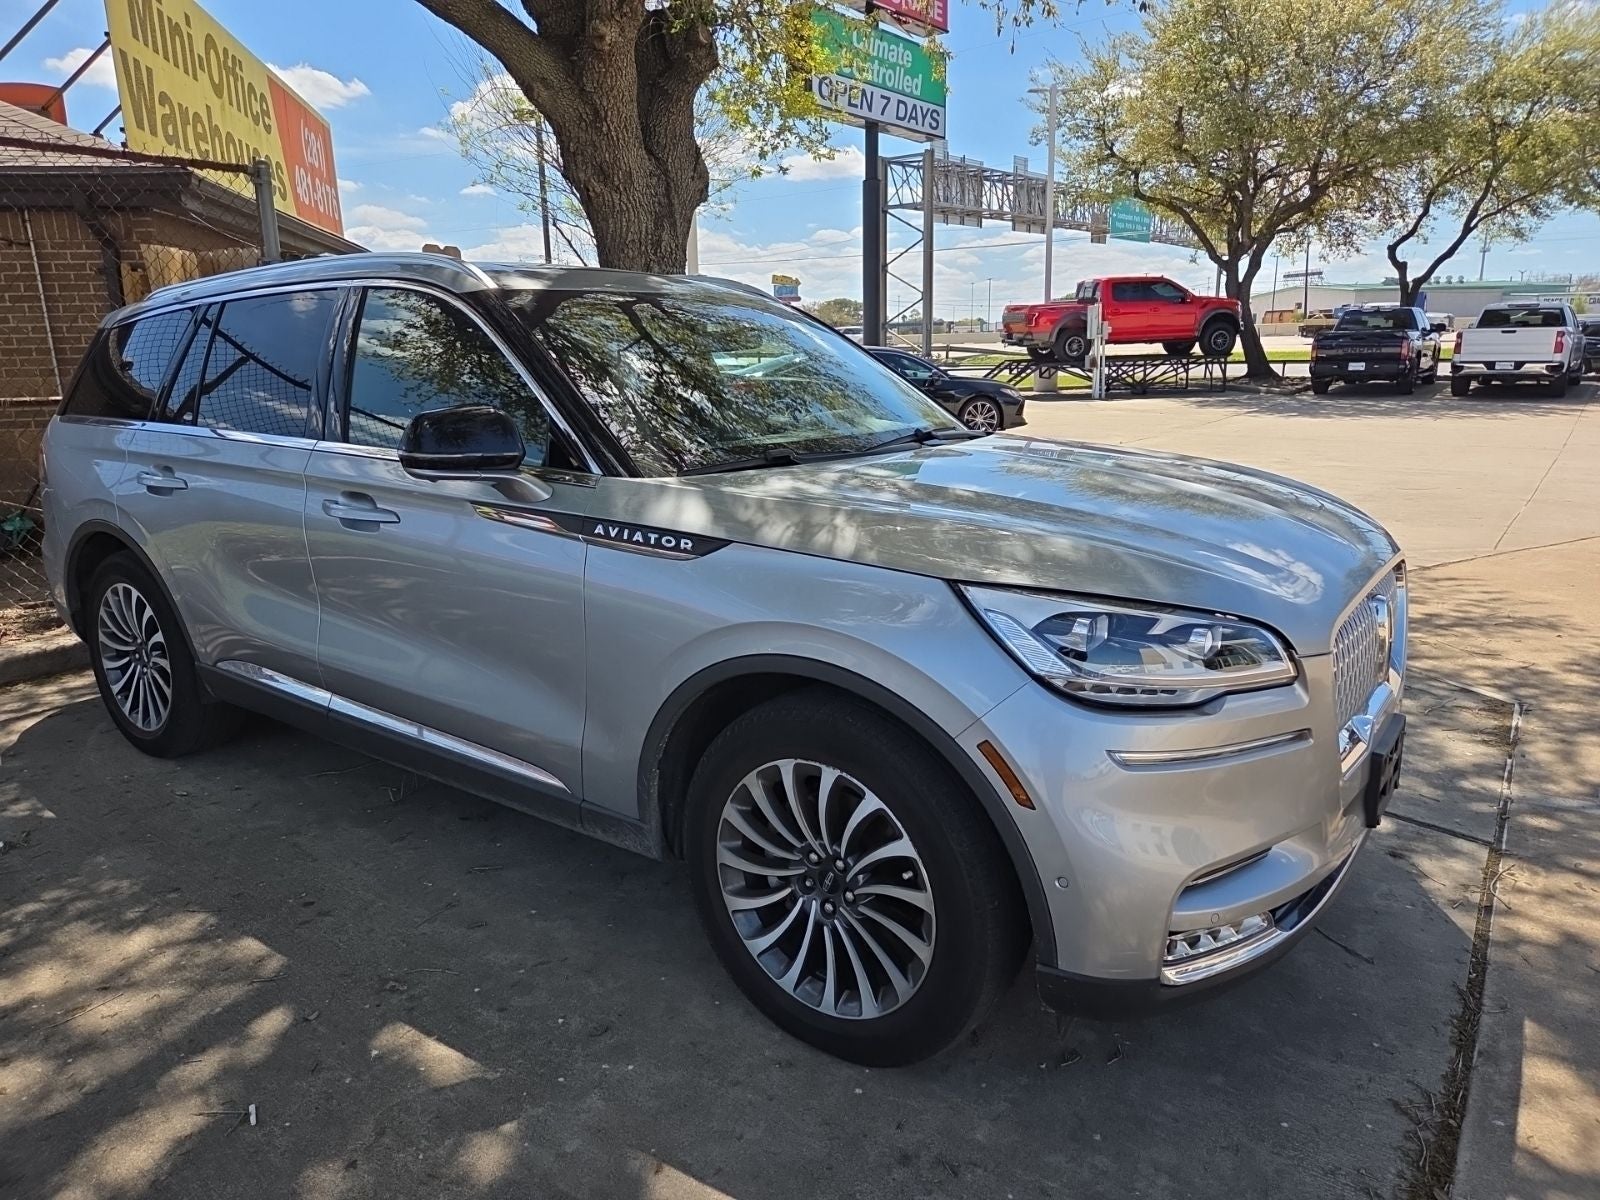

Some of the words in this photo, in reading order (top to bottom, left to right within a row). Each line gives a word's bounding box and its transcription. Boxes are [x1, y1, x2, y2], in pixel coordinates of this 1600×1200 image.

[880, 94, 891, 116] 7
[896, 99, 941, 131] DAYS
[300, 119, 326, 178] (281)
[593, 523, 694, 551] AVIATOR
